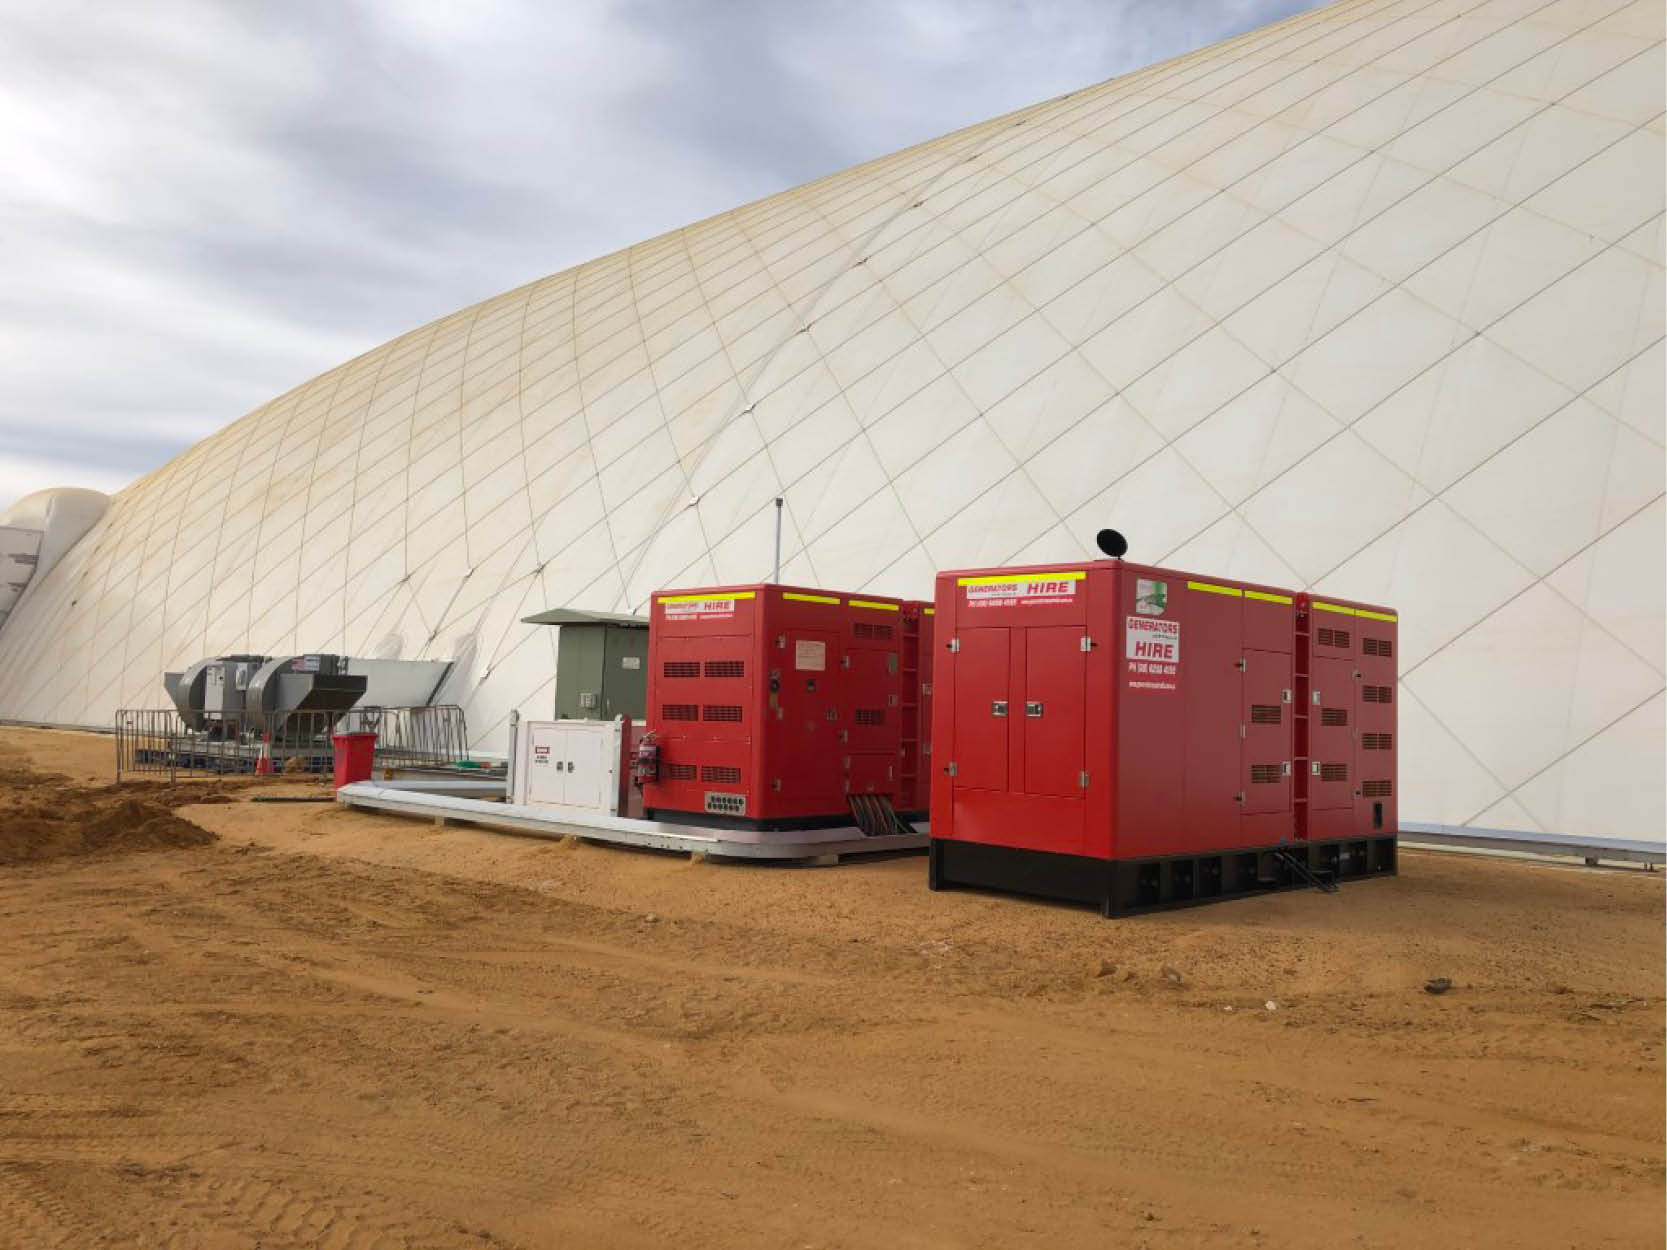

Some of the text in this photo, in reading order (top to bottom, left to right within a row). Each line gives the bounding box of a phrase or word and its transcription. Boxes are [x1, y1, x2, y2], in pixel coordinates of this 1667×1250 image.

[1027, 581, 1069, 594] HIRE
[704, 601, 730, 610] HIRE
[1127, 618, 1178, 634] GENERATORS
[1135, 641, 1174, 659] HIRE
